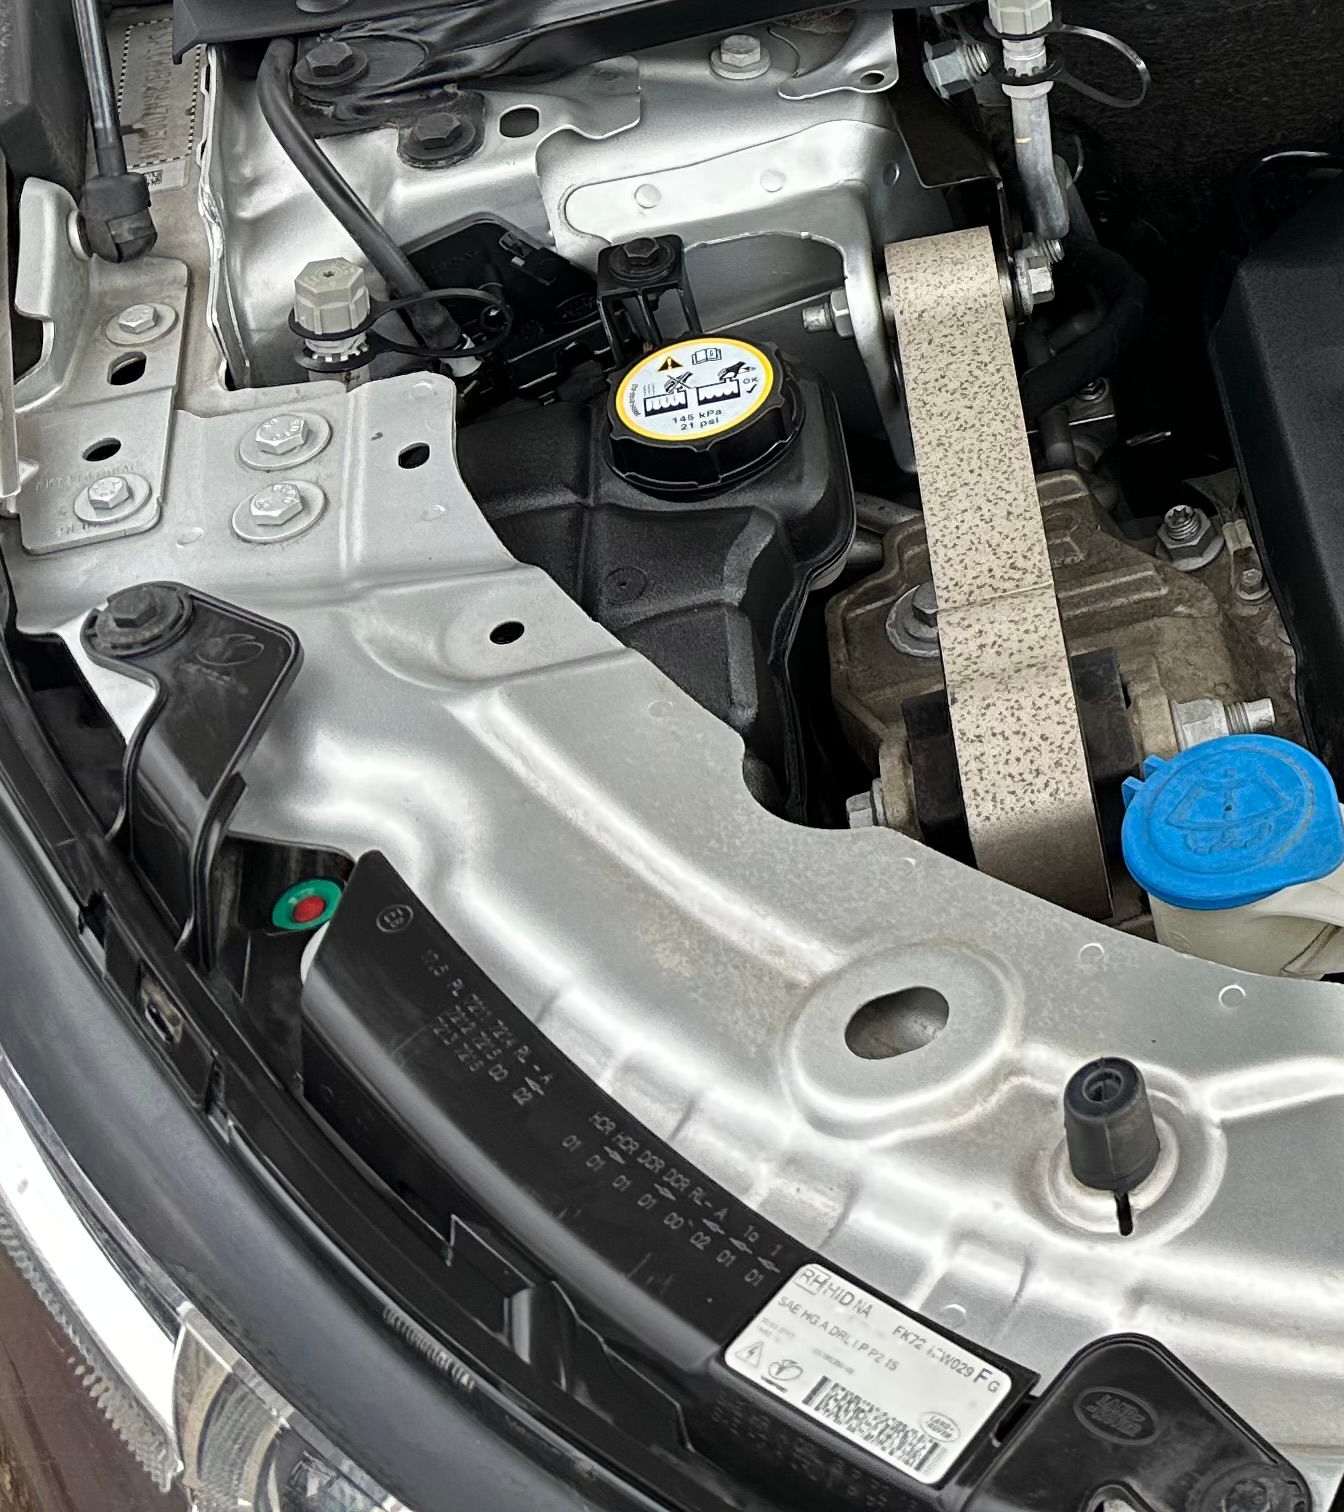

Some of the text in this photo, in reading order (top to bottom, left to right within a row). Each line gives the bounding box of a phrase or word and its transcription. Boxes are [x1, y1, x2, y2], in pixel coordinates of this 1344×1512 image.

[742, 376, 759, 385] OK
[671, 408, 722, 424] 145 kPa
[680, 417, 719, 430] 21 psi
[561, 1134, 581, 1151] 01
[585, 1154, 605, 1171] 01
[611, 1174, 631, 1191] 01
[636, 1193, 657, 1210] 01
[689, 1231, 711, 1250] 02
[715, 1249, 736, 1267] 01
[743, 1268, 764, 1287] 01
[799, 1267, 873, 1317] RH HID NA
[777, 1296, 802, 1314] SAE
[817, 1320, 829, 1330] A
[857, 1341, 870, 1351] P
[867, 1347, 885, 1363] P2
[884, 1358, 898, 1371] 15
[892, 1325, 926, 1350] FK72
[972, 1367, 993, 1383] F
[986, 1379, 1001, 1393] G
